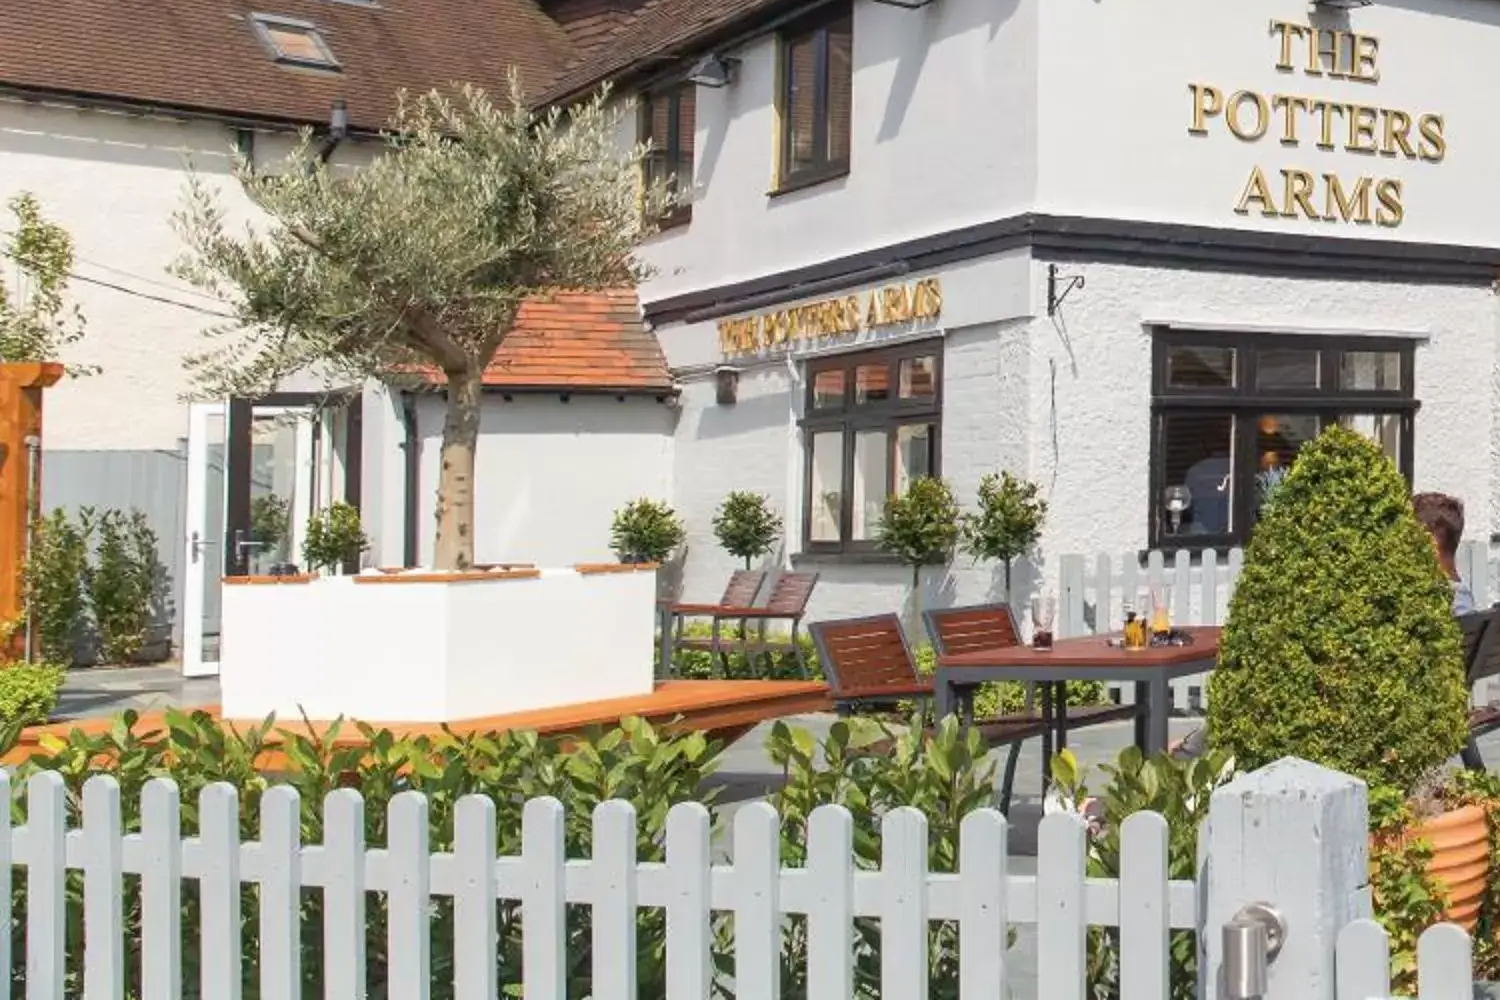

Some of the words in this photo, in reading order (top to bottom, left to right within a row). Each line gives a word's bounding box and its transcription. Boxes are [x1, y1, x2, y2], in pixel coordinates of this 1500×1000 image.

[1270, 19, 1380, 84] THE
[1187, 83, 1447, 162] POTTERS
[1233, 164, 1405, 227] ARMS
[716, 314, 759, 356] THE
[762, 295, 862, 346] POTTERS
[866, 277, 943, 329] ARMS
